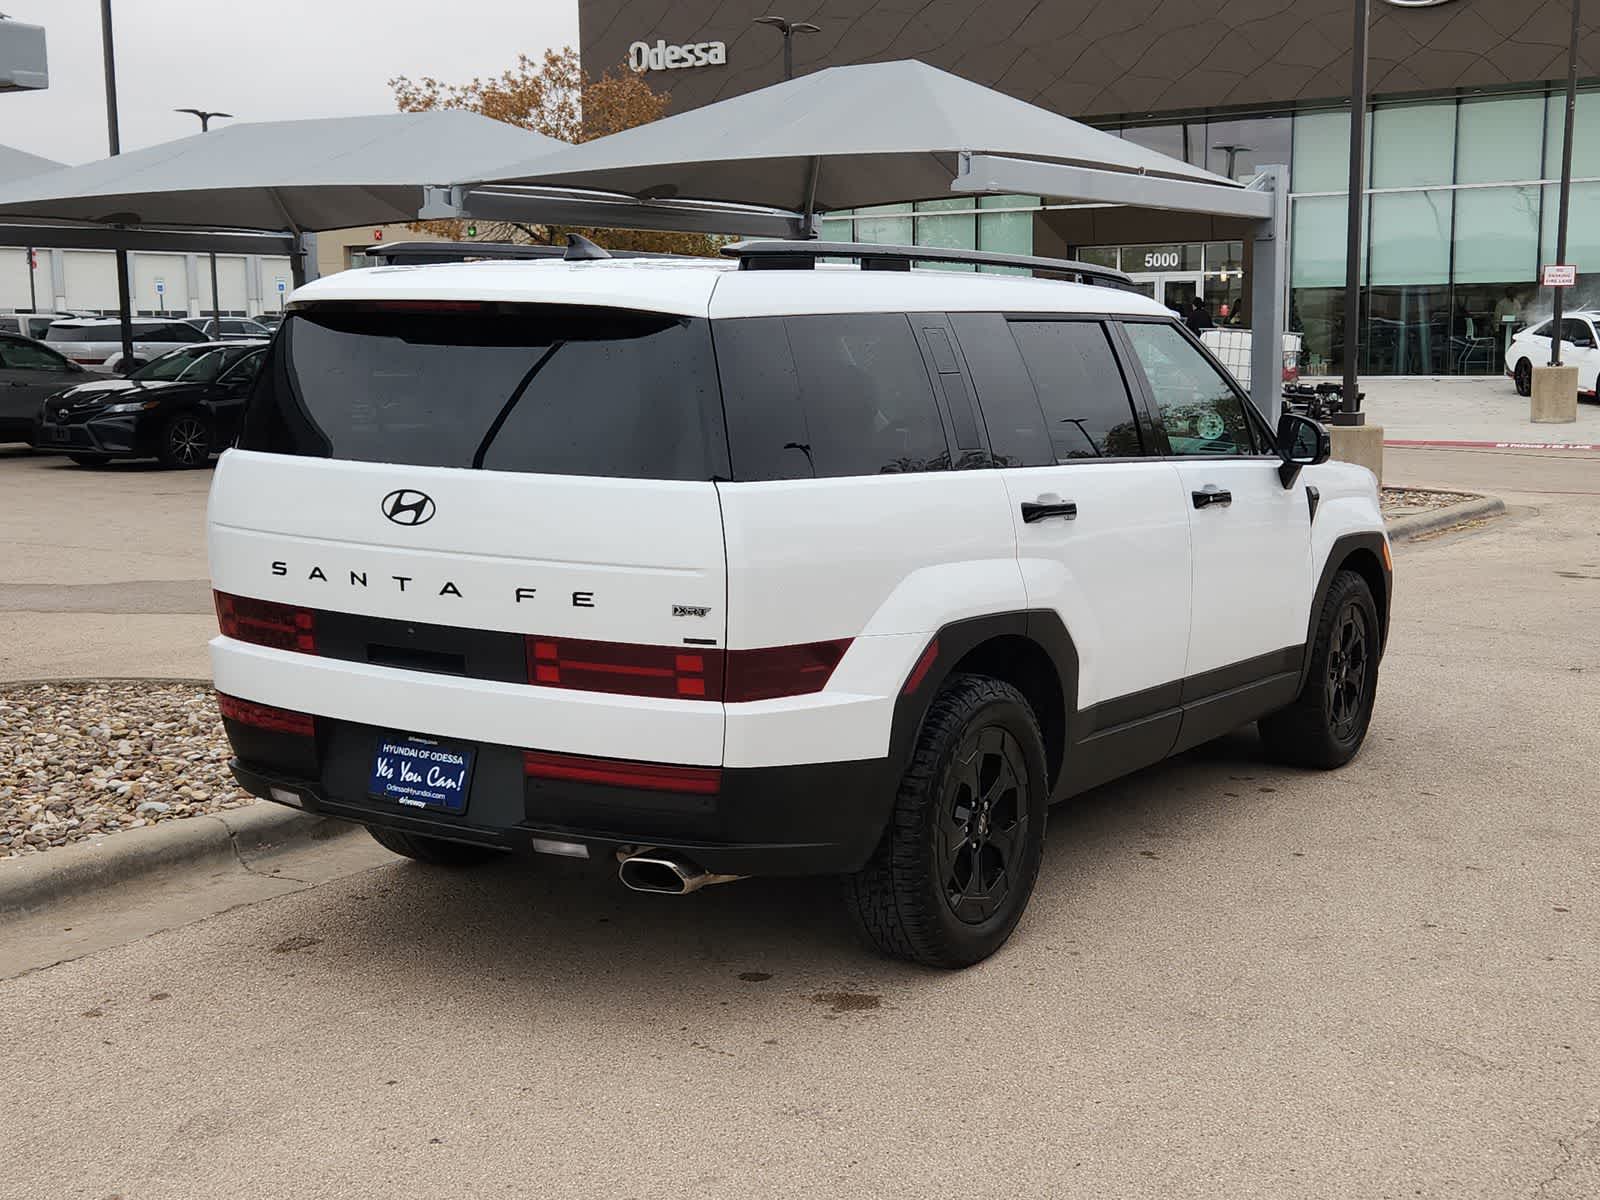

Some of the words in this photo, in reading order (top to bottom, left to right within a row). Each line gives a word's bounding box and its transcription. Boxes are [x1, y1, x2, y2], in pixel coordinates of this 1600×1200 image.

[629, 40, 726, 72] Odessa
[1144, 252, 1179, 267] 5000
[271, 560, 463, 598] SANTA
[515, 587, 596, 608] FE
[383, 743, 418, 757] HYUNDAI
[419, 750, 430, 759] OF
[430, 752, 464, 765] ODESSA
[376, 757, 394, 779] Yes
[400, 761, 422, 782] You
[426, 766, 465, 791] Can!
